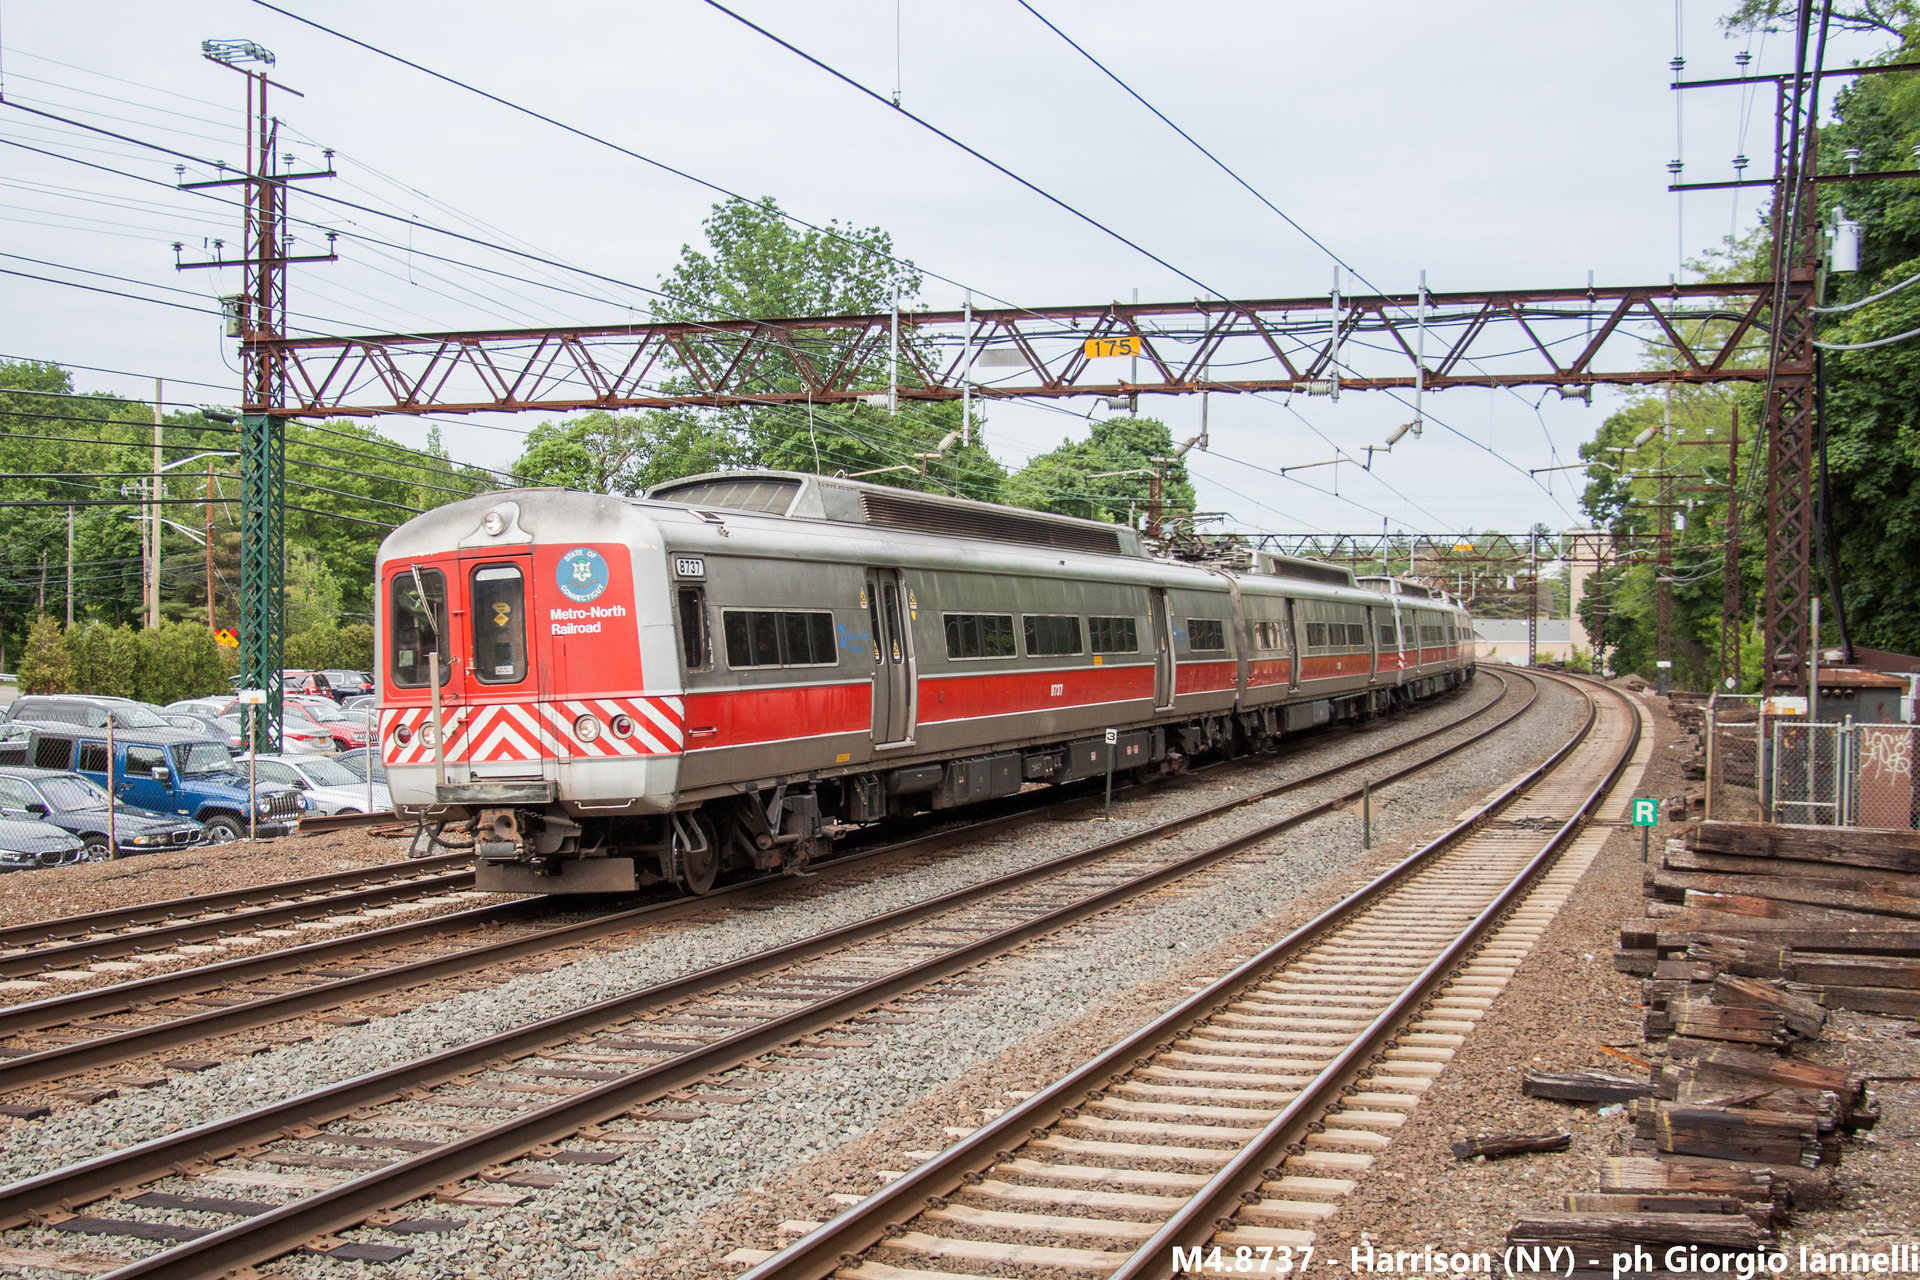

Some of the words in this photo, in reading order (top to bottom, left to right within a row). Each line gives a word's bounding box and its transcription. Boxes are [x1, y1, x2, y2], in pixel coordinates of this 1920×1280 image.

[1095, 339, 1132, 357] 175
[563, 548, 584, 562] STATE
[586, 549, 597, 559] OF
[679, 560, 701, 574] 8737
[560, 583, 605, 603] CONNECTICUT
[550, 605, 626, 621] Metro-North
[551, 621, 602, 636] Railroad
[1107, 732, 1115, 741] 3
[1636, 801, 1654, 822] R
